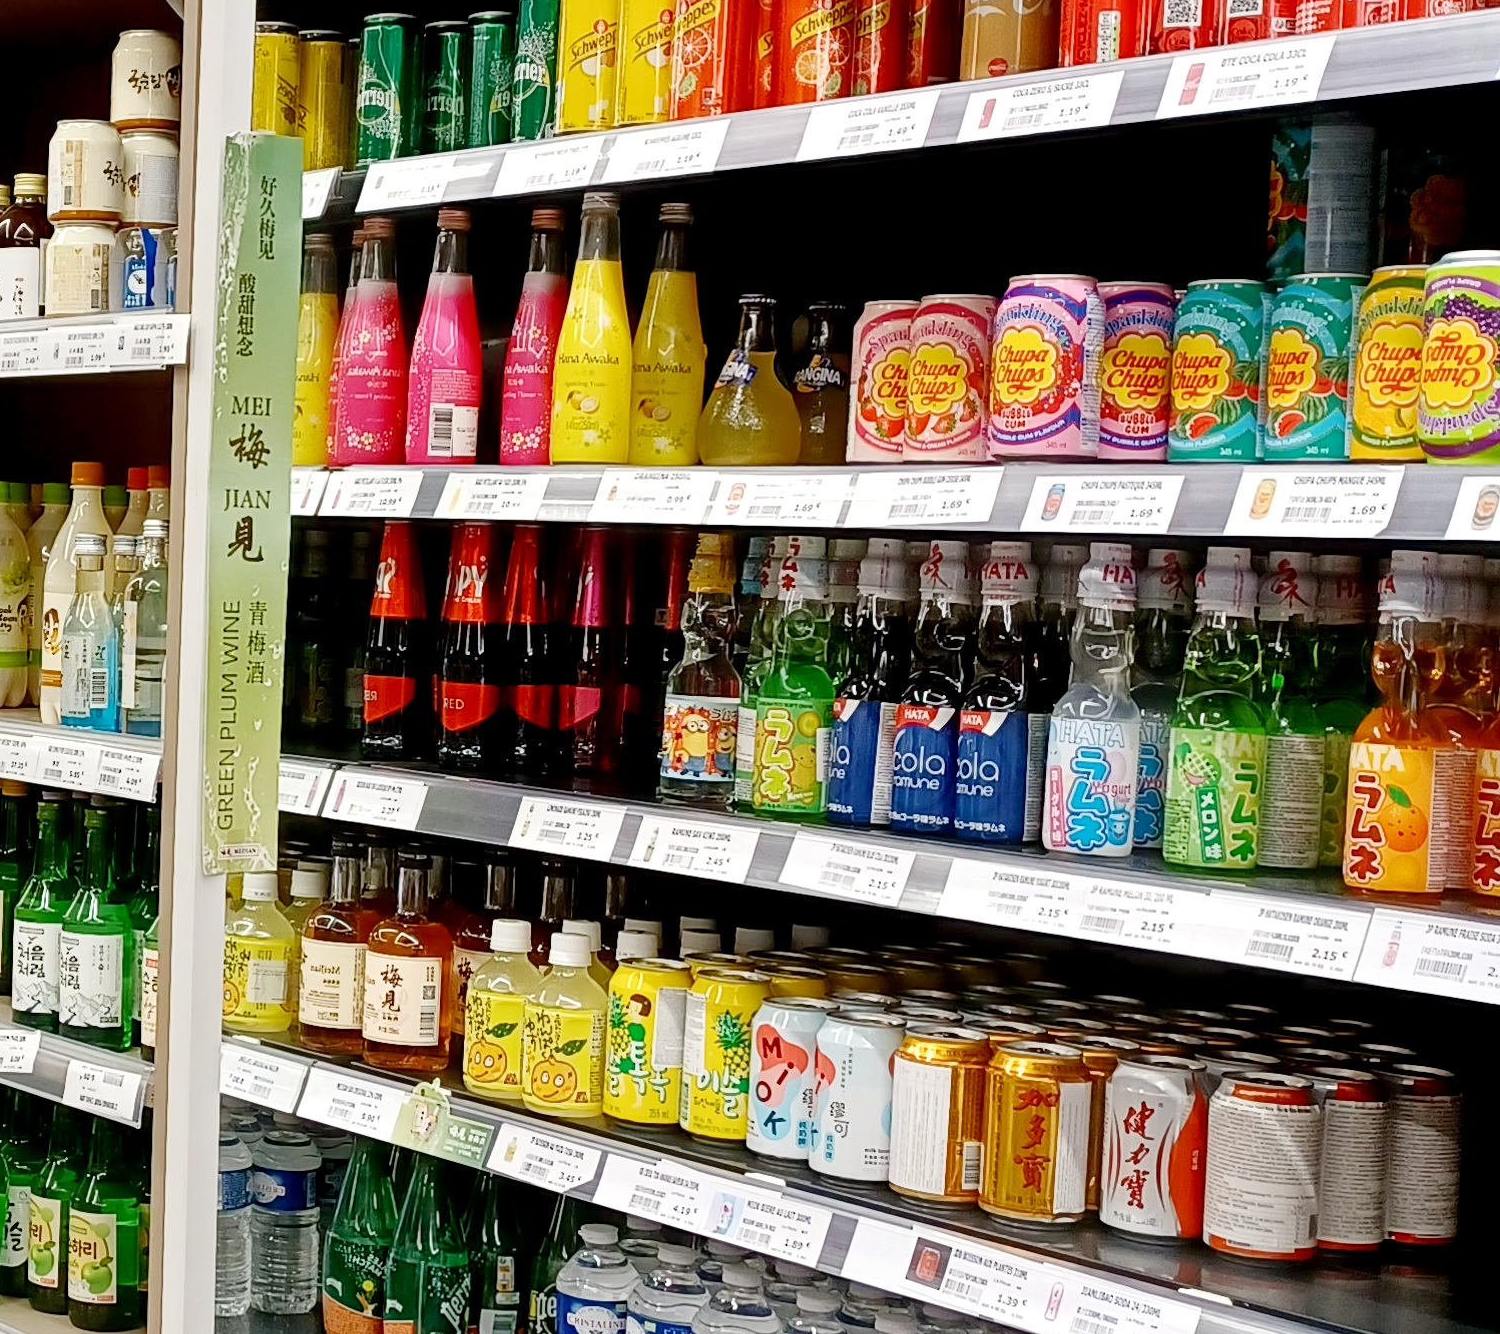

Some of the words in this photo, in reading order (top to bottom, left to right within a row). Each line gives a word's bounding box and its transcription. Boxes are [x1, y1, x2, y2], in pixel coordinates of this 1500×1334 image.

[1238, 54, 1262, 66] COCA
[1263, 51, 1285, 63] COLA
[1273, 76, 1299, 89] 1.19
[1058, 106, 1081, 117] 1.19
[888, 126, 908, 137] 1.49
[258, 175, 278, 261] 好久梅见
[235, 272, 257, 357] 酸甜想念
[559, 353, 579, 364] Hana
[581, 354, 619, 365] Awaka
[998, 345, 1050, 366] Chupa
[1111, 349, 1169, 371] Chupa
[1175, 352, 1222, 371] Chupa
[513, 363, 548, 374] Awaka
[652, 363, 691, 374] Awaka
[912, 359, 961, 381] Chupa
[996, 365, 1045, 394] Chups
[1107, 369, 1166, 400] Chups
[1172, 367, 1219, 400] Chups
[910, 377, 957, 405] Chups
[231, 396, 272, 417] MEI
[1001, 409, 1032, 420] BUBBLE
[1004, 419, 1027, 429] GUM
[1118, 413, 1156, 425] BUBBLE
[1124, 424, 1150, 434] GUM
[228, 423, 271, 469] 梅
[224, 488, 272, 510] JIAN
[793, 503, 813, 512] 1.69
[941, 500, 962, 509] 1.69
[1129, 508, 1153, 518] 1.69
[1350, 504, 1377, 515] 1.69
[226, 515, 264, 563] 見
[222, 600, 241, 666] WINE
[245, 601, 268, 685] 青梅酒
[220, 673, 238, 740] PLUM
[443, 696, 465, 711] RED
[903, 708, 930, 721] HATA
[962, 714, 984, 726] HATA
[1058, 718, 1126, 748] HATA
[760, 708, 794, 797] ラムネ
[893, 745, 946, 776] cola
[217, 749, 236, 830] GREEN
[1091, 780, 1132, 798] Yogurt
[1066, 747, 1111, 851] ラムネ
[1229, 761, 1261, 863] ラムネ
[1199, 791, 1223, 862] メロン味
[1345, 773, 1387, 883] ラムネ
[868, 878, 888, 890] 2.15
[1037, 906, 1060, 918] 2.15
[1140, 921, 1165, 933] 2.15
[17, 941, 46, 962] 처음
[1311, 948, 1337, 961] 2.15
[16, 961, 46, 979] 처럼
[380, 963, 404, 1013] 梅見
[696, 1064, 741, 1119] 이슬
[558, 1171, 576, 1183] 3.45
[672, 1204, 692, 1215] 4.19
[996, 1293, 1019, 1308] 1.39
[1080, 1285, 1114, 1306] JIANLIBAO
[1114, 1294, 1132, 1309] SODA
[566, 1316, 624, 1332] CRISTALINE
